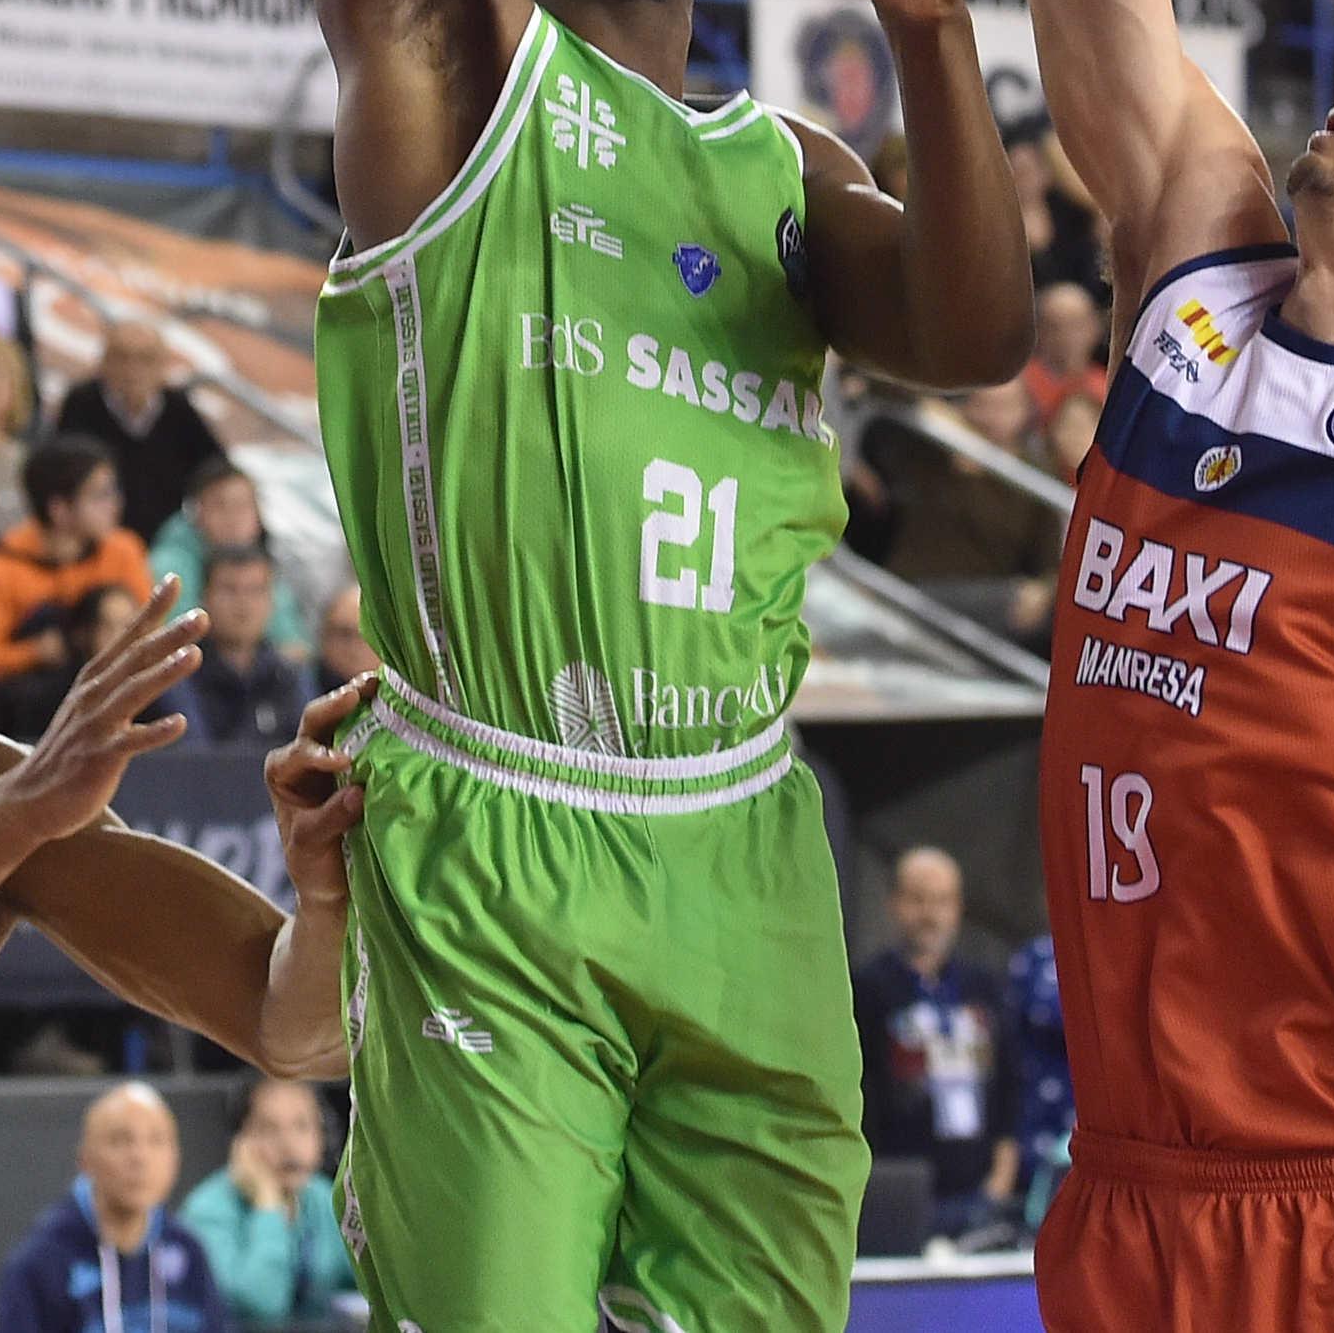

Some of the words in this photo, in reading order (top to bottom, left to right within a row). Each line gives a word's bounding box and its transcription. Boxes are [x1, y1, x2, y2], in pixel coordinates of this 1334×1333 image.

[520, 312, 605, 377] BdS
[625, 332, 828, 446] SASSAR
[638, 457, 739, 614] 21
[1074, 516, 1273, 655] BAXI
[1075, 635, 1206, 718] MANRESA
[1080, 762, 1161, 904] 19
